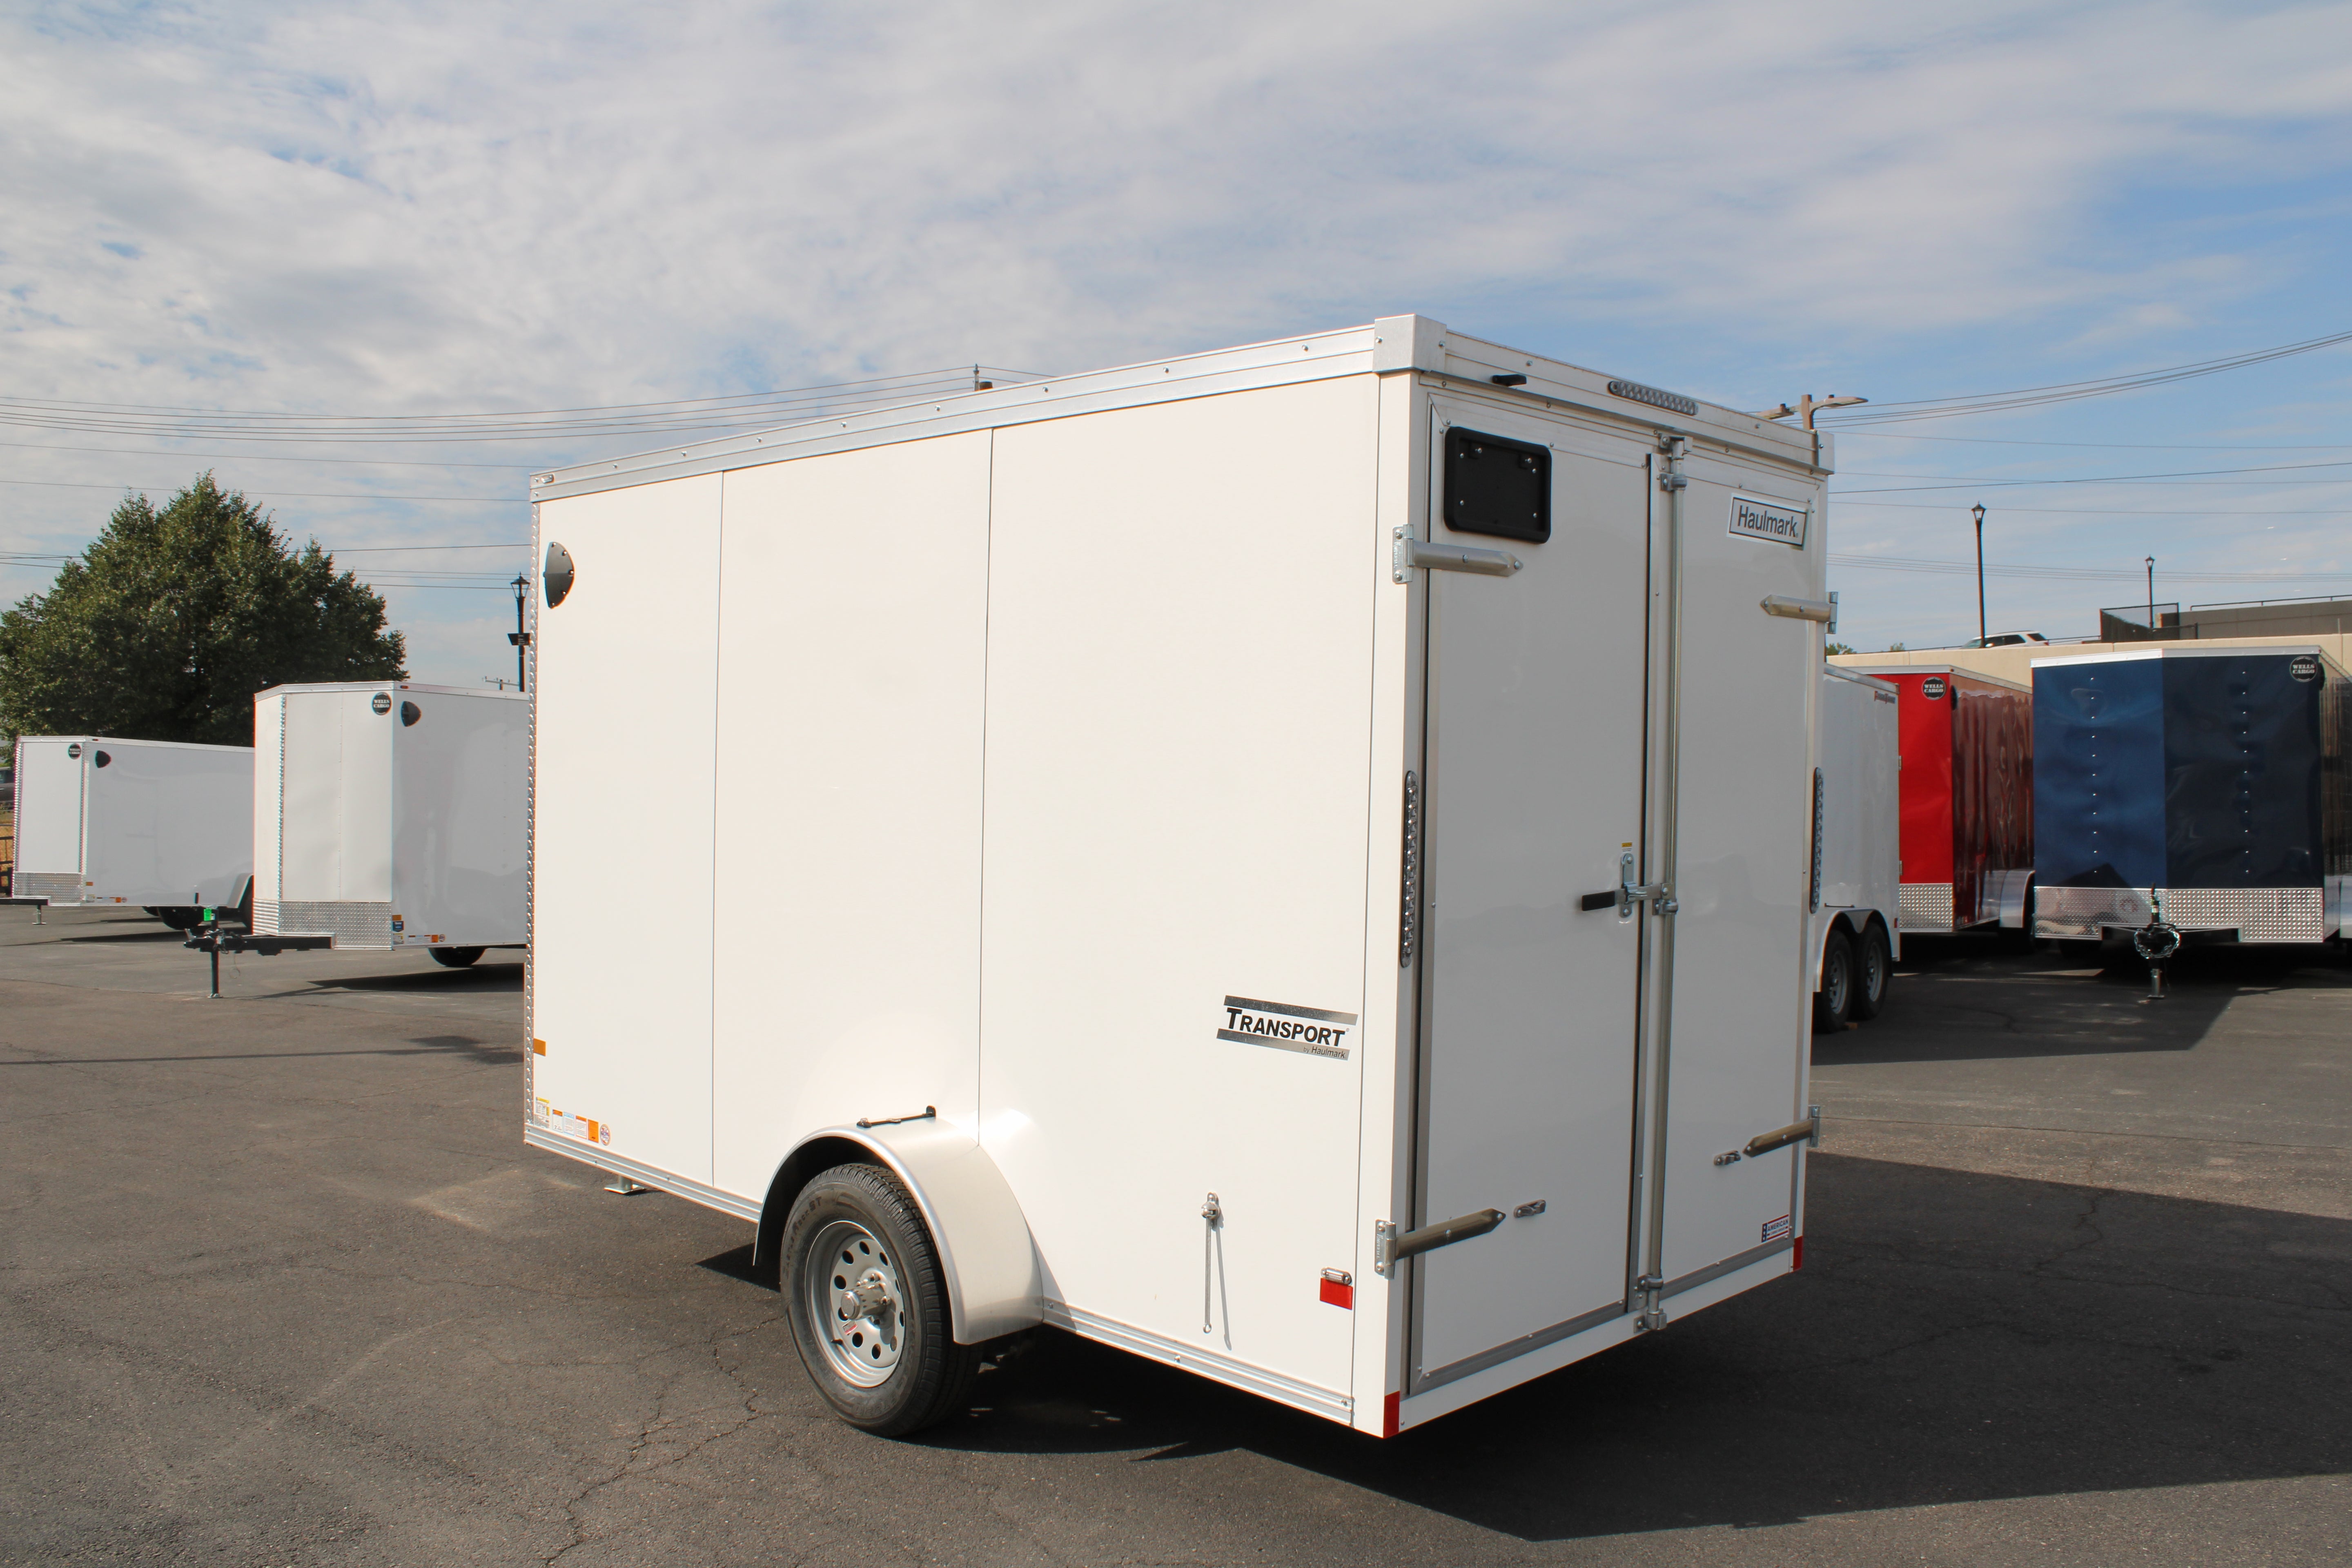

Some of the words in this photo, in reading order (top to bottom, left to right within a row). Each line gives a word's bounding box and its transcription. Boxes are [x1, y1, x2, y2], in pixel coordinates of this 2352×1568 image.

[1737, 505, 1797, 537] Haulmark
[1227, 1007, 1345, 1047] TRANSPORT
[1311, 1046, 1345, 1058] Haulmark
